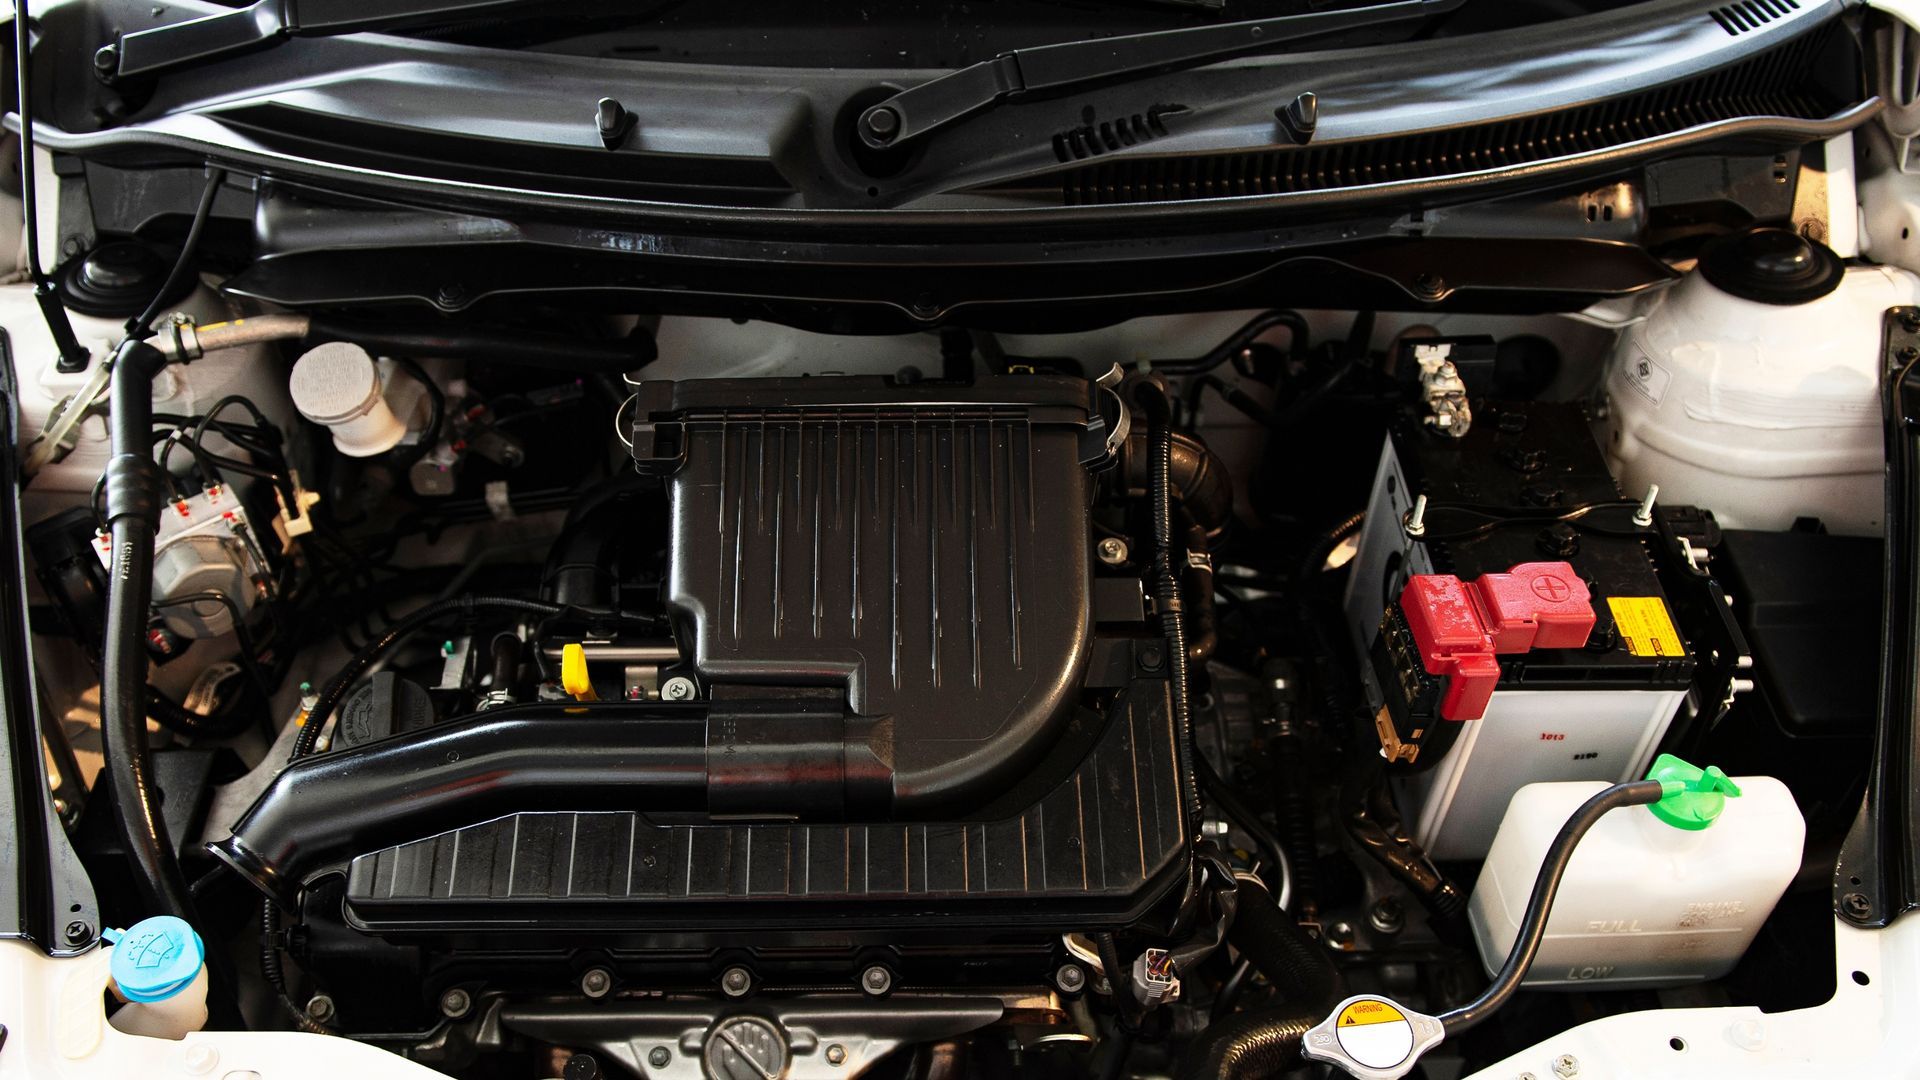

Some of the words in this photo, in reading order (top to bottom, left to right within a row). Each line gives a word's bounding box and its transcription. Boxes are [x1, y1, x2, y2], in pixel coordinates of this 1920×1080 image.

[1588, 920, 1642, 933] FULL
[1567, 966, 1615, 980] LOW
[1352, 1003, 1383, 1015] WARNING
